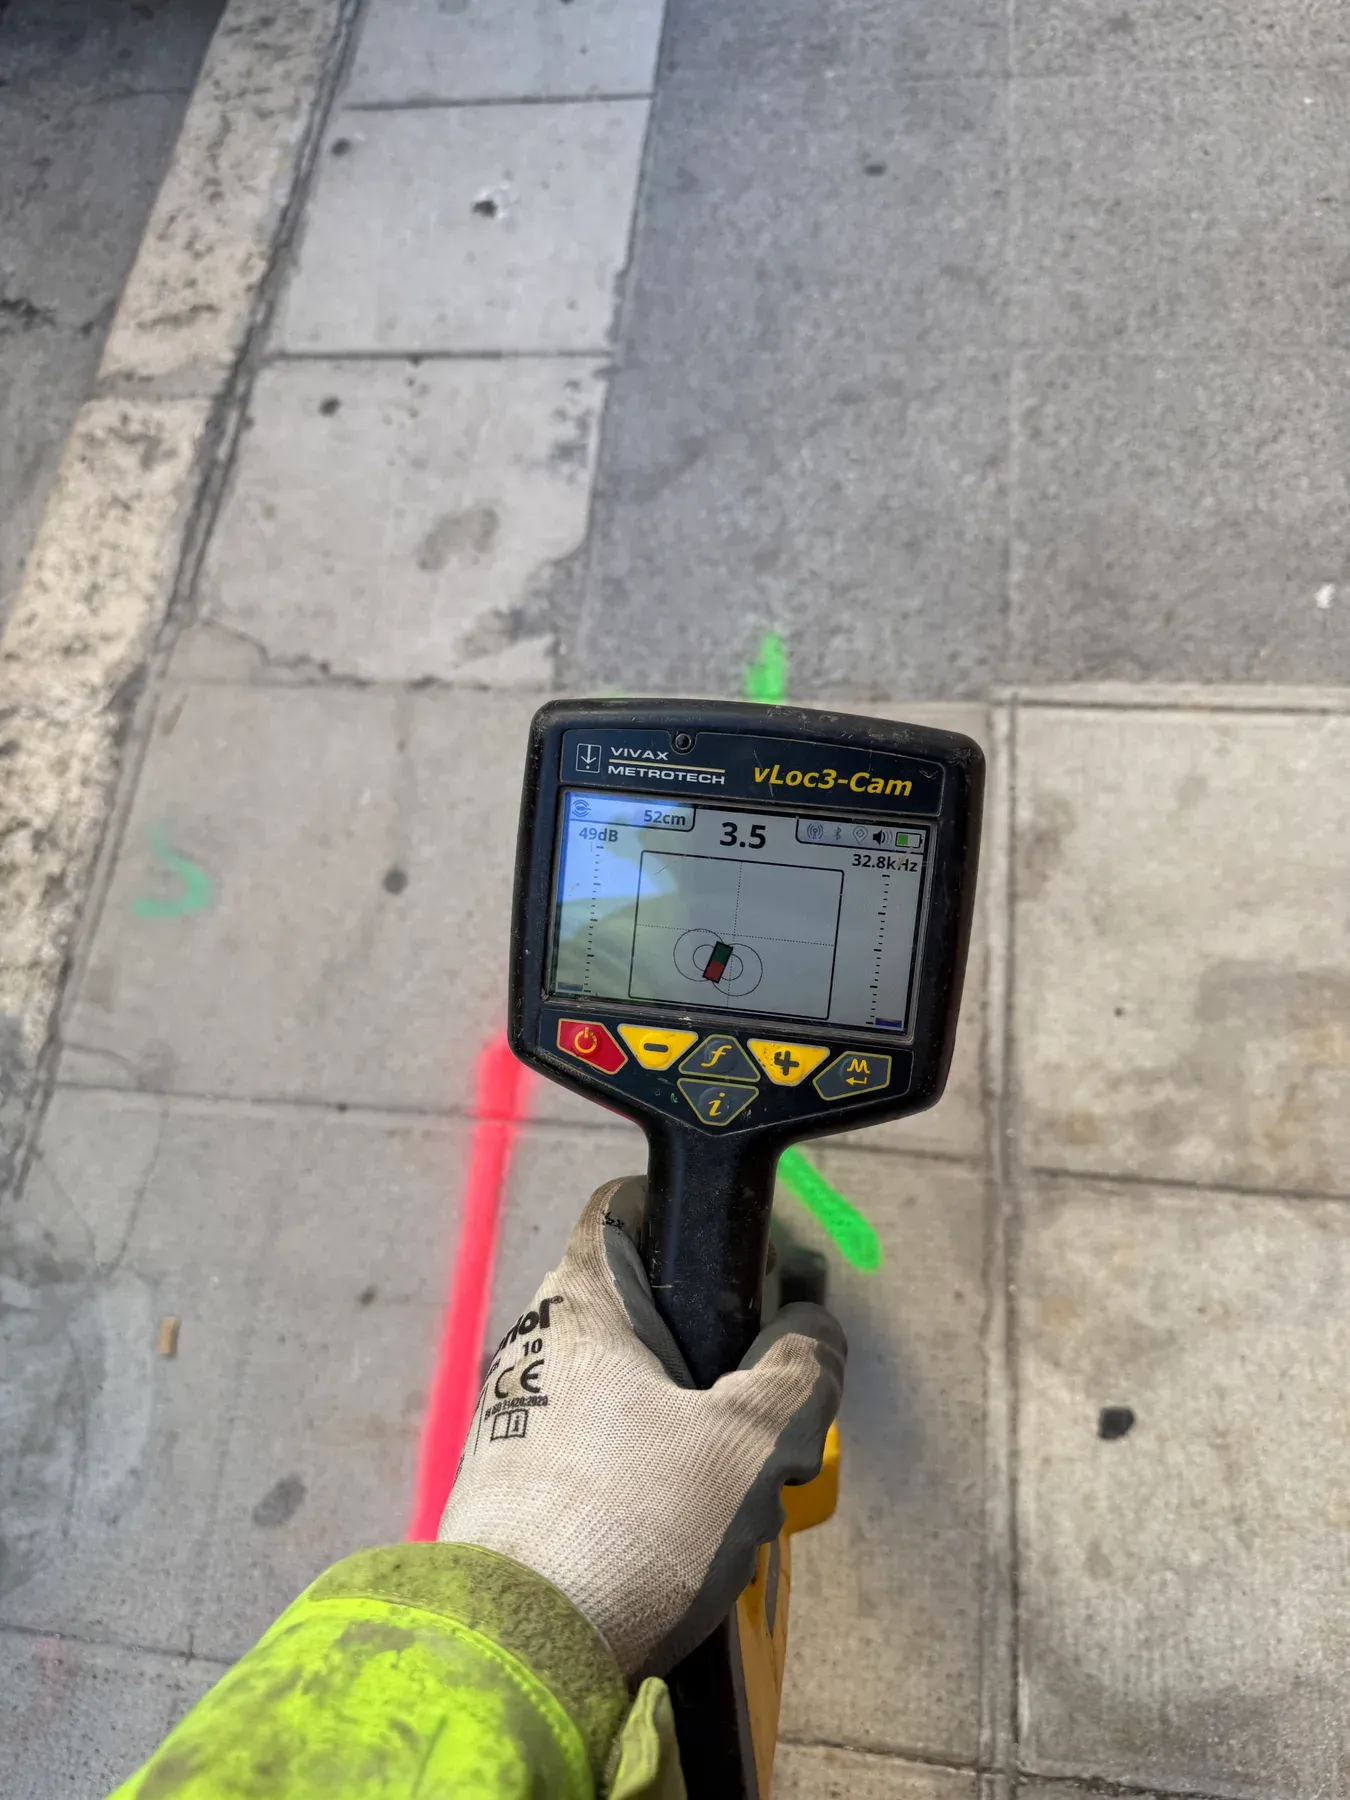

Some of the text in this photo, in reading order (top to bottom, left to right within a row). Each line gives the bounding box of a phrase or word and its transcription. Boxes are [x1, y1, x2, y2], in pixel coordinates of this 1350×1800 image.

[610, 747, 669, 761] VIVAX
[608, 765, 725, 785] METROTECH
[753, 765, 913, 796] vLoc3-Cam
[643, 809, 686, 826] 52cm
[578, 827, 619, 843] 49dB
[719, 822, 767, 849] 3.5
[852, 854, 918, 873] 32.8kHz
[522, 1338, 543, 1357] 10
